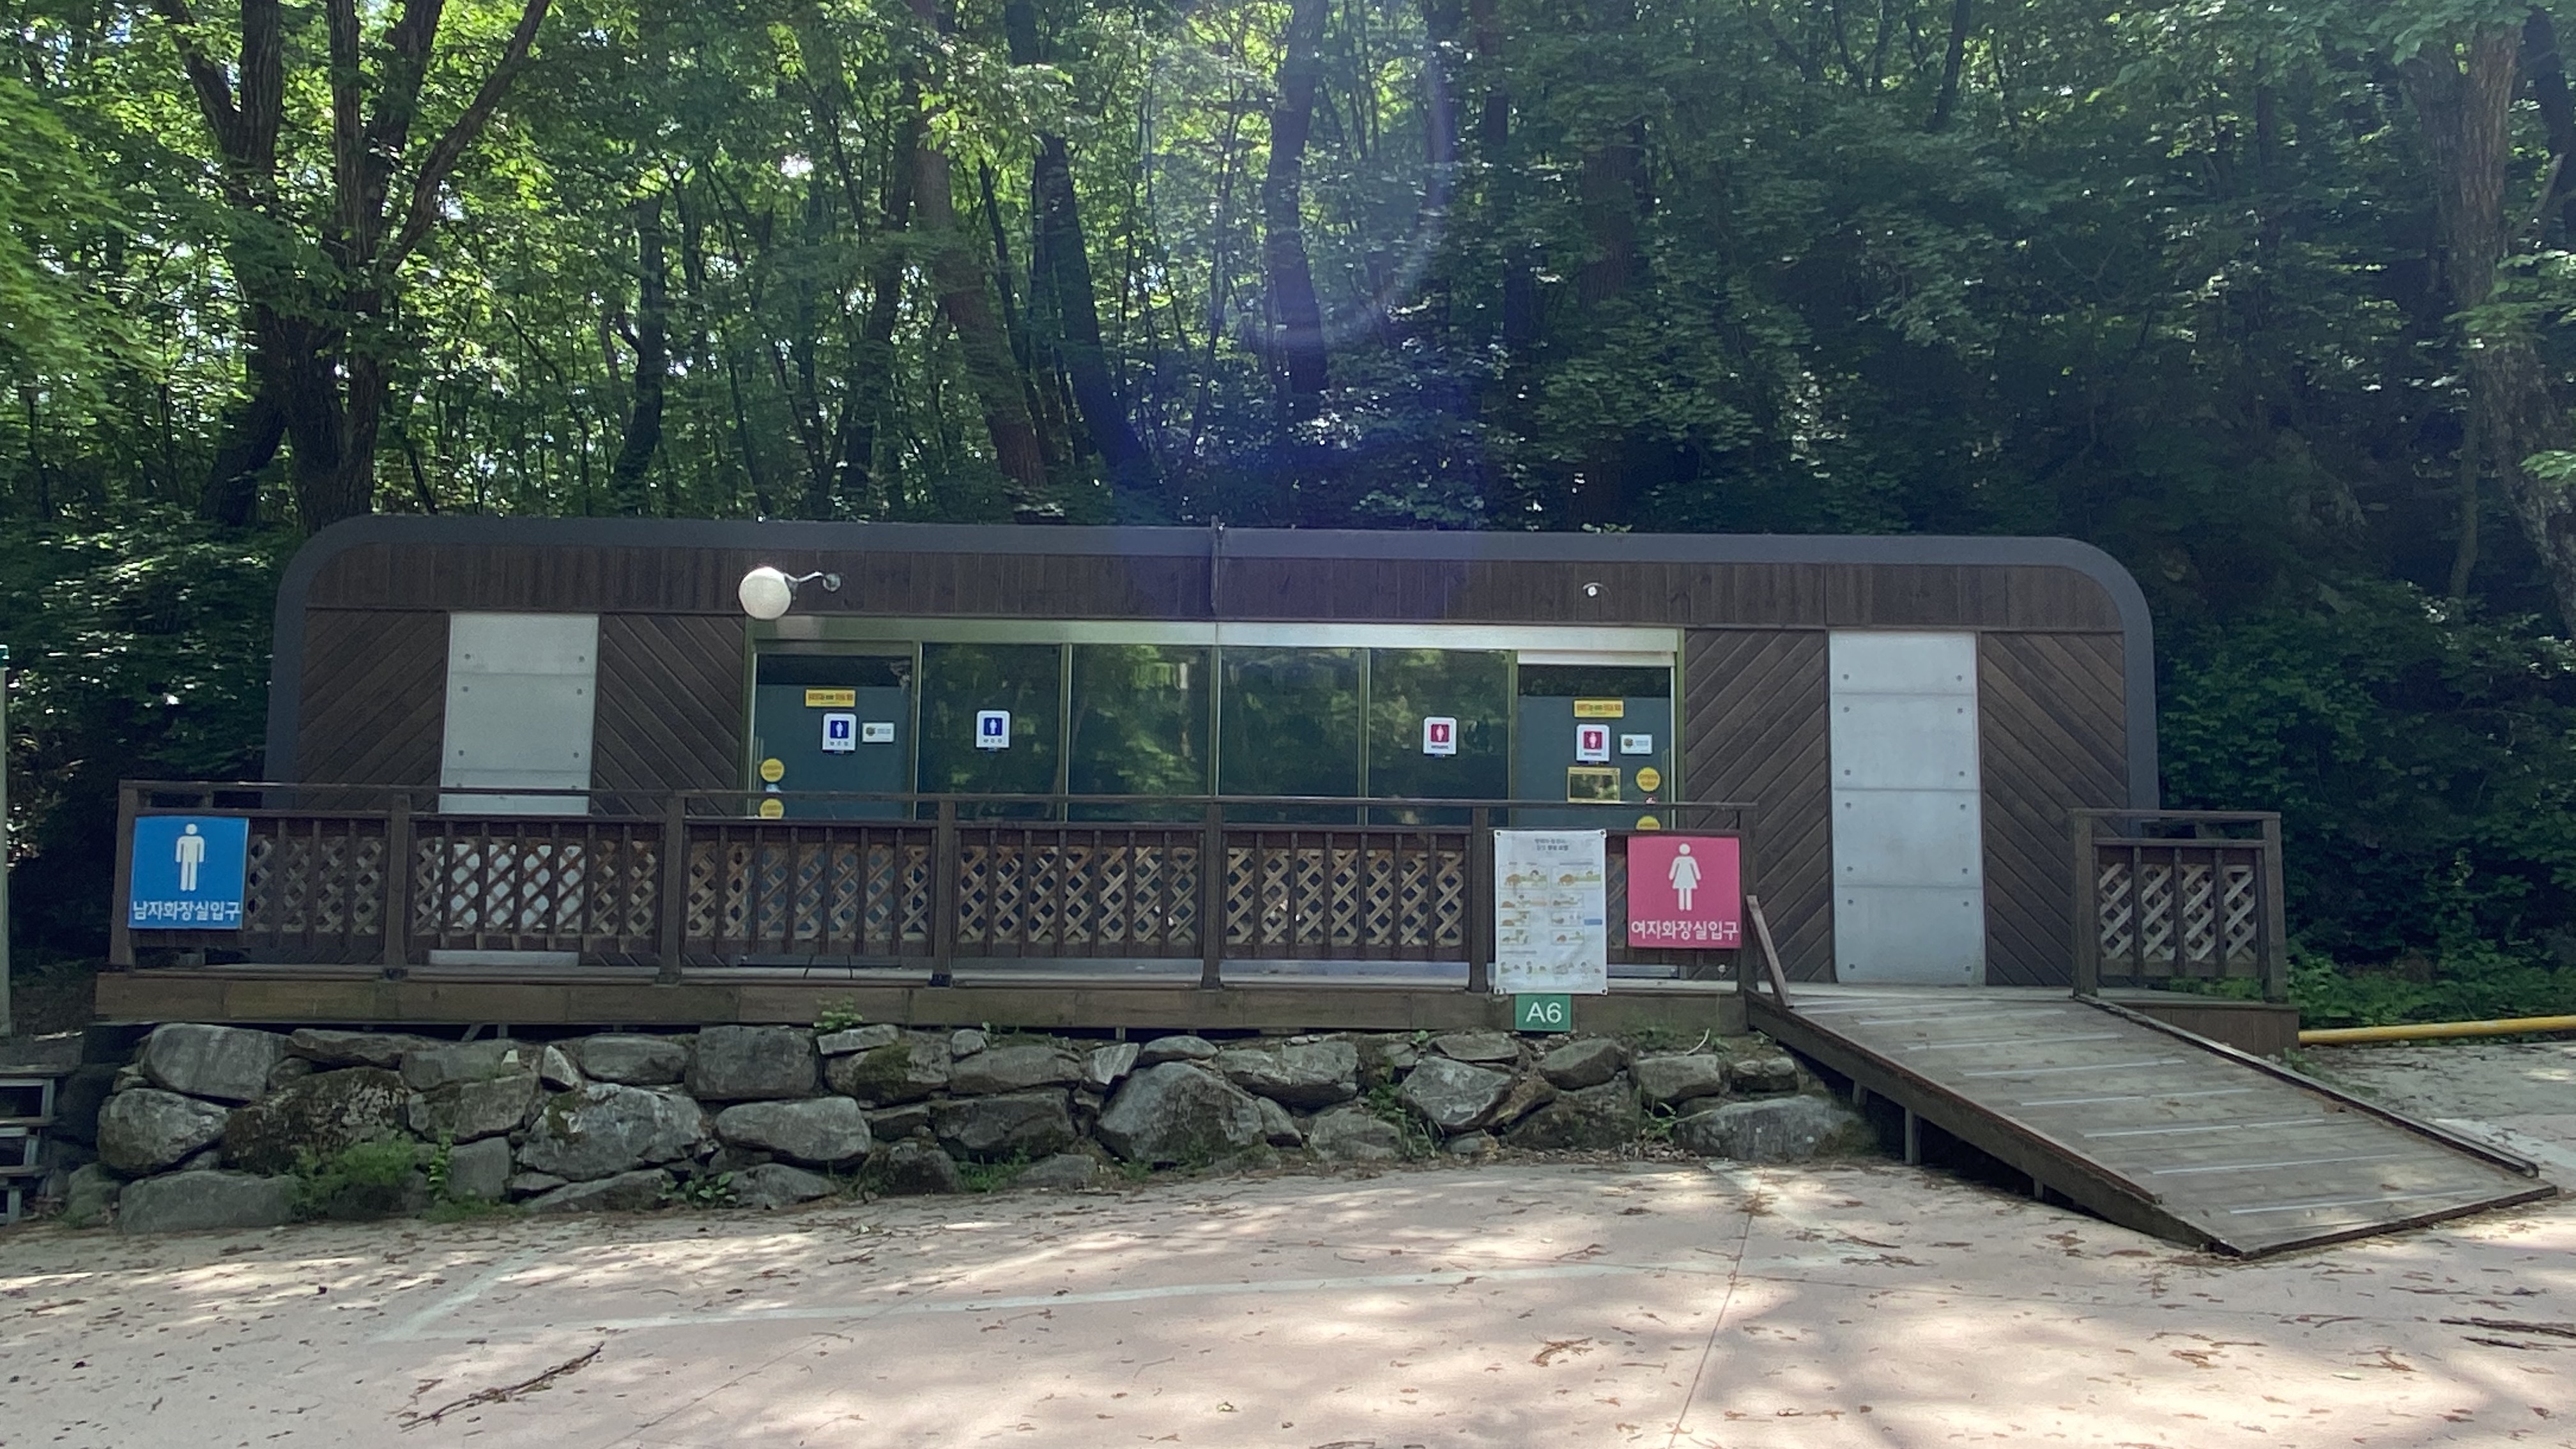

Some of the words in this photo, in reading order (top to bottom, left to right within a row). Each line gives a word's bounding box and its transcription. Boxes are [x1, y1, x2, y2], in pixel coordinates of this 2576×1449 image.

[133, 900, 241, 921] 남자화장실입구
[1631, 920, 1738, 940] 여자화장실입구
[1526, 1002, 1562, 1023] A6
